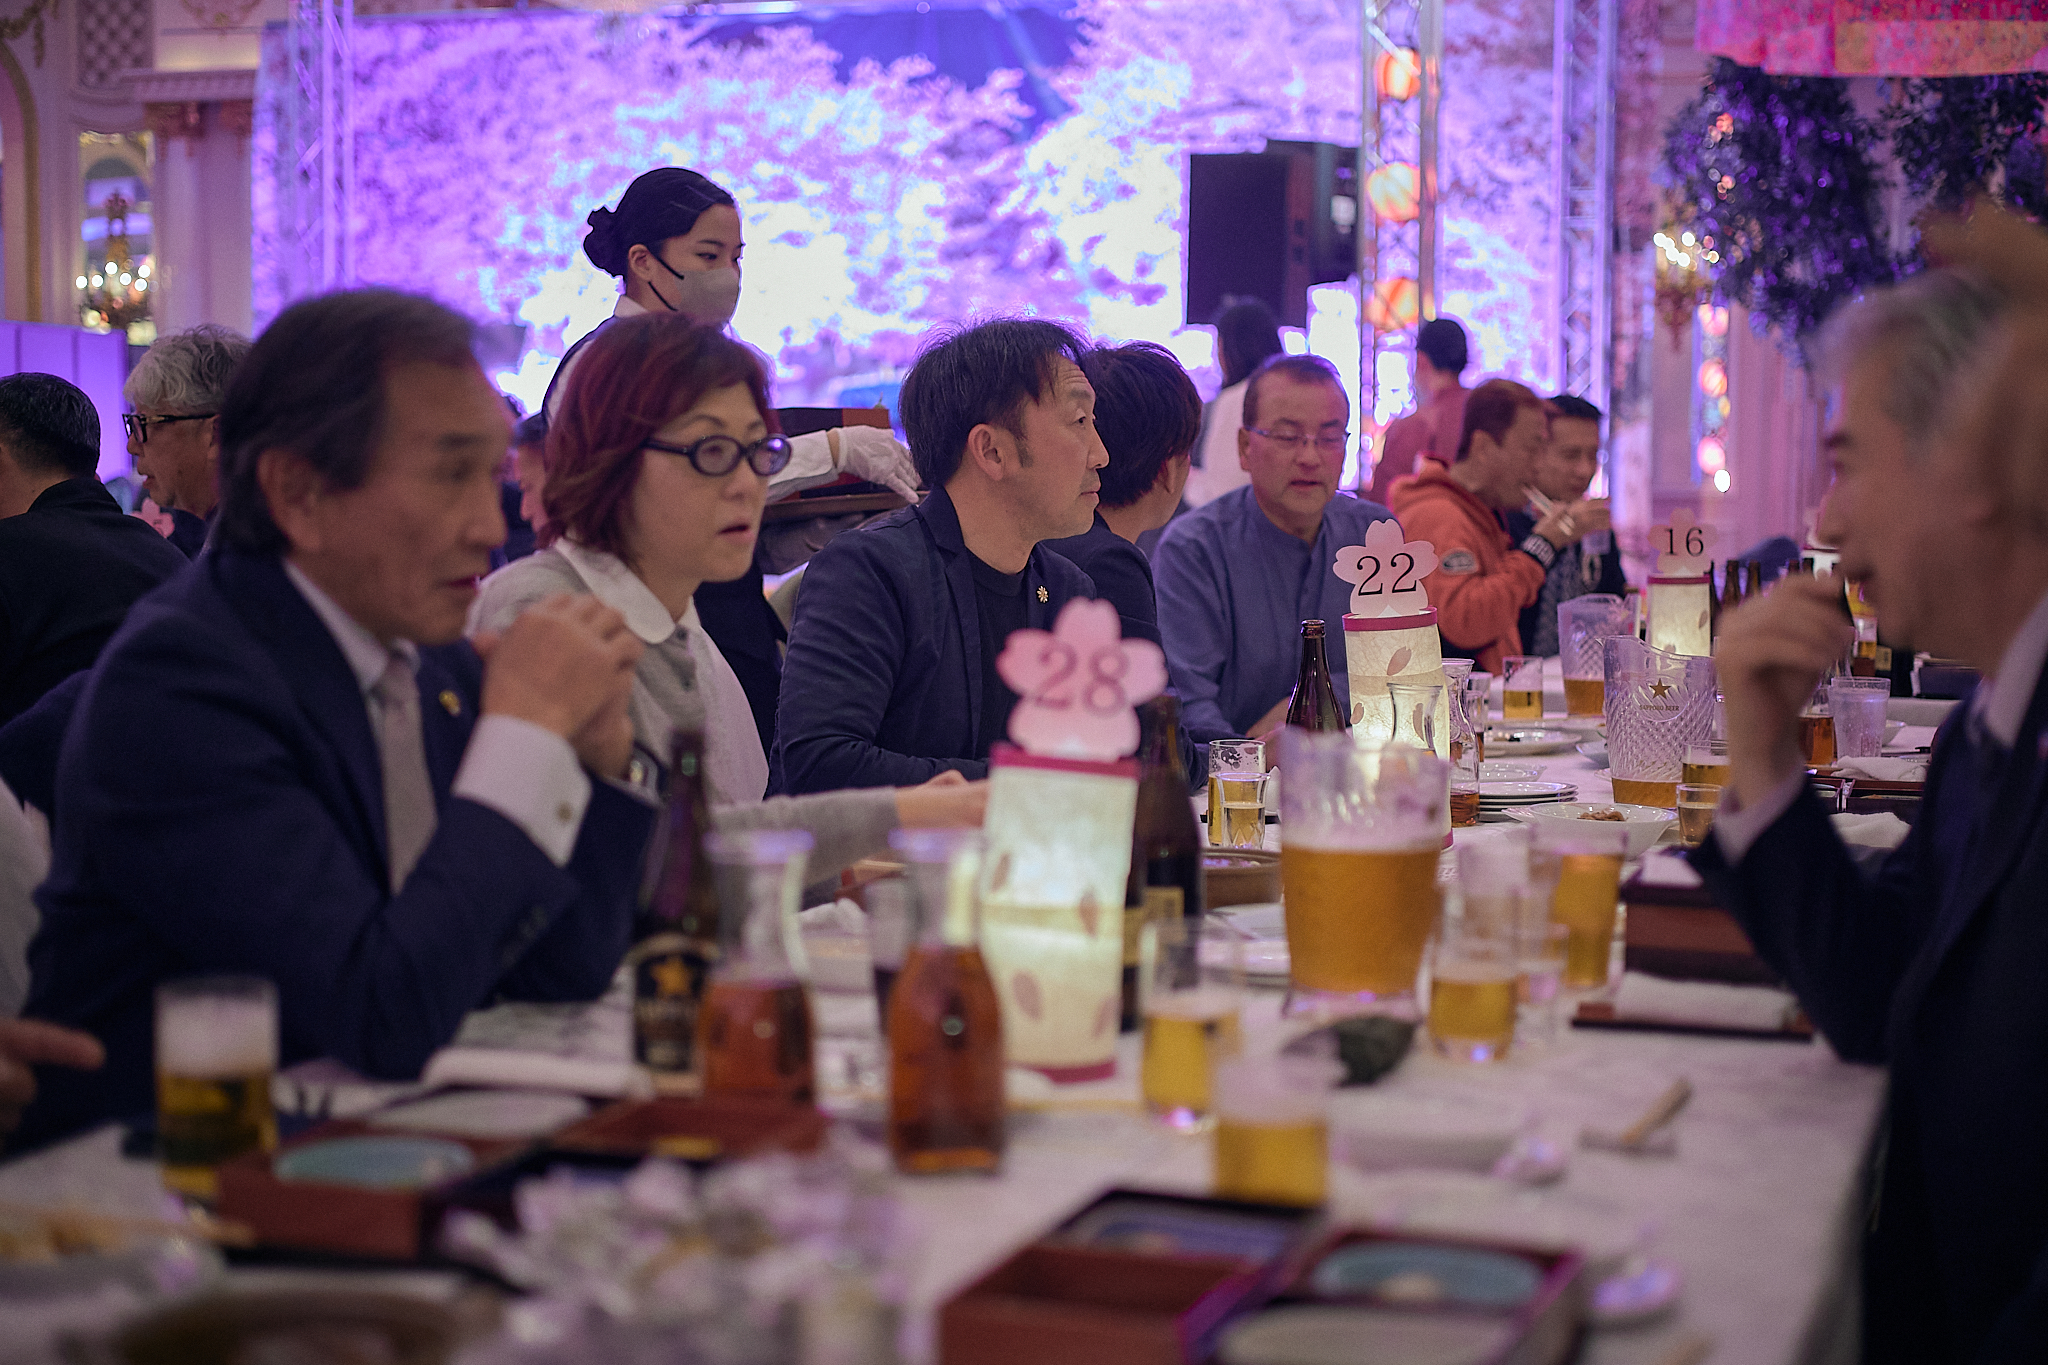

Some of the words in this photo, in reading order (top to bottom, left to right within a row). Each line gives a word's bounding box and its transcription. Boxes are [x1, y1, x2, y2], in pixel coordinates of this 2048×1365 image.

[1664, 526, 1704, 557] 16
[1357, 552, 1417, 597] 22
[1034, 642, 1129, 718] 28
